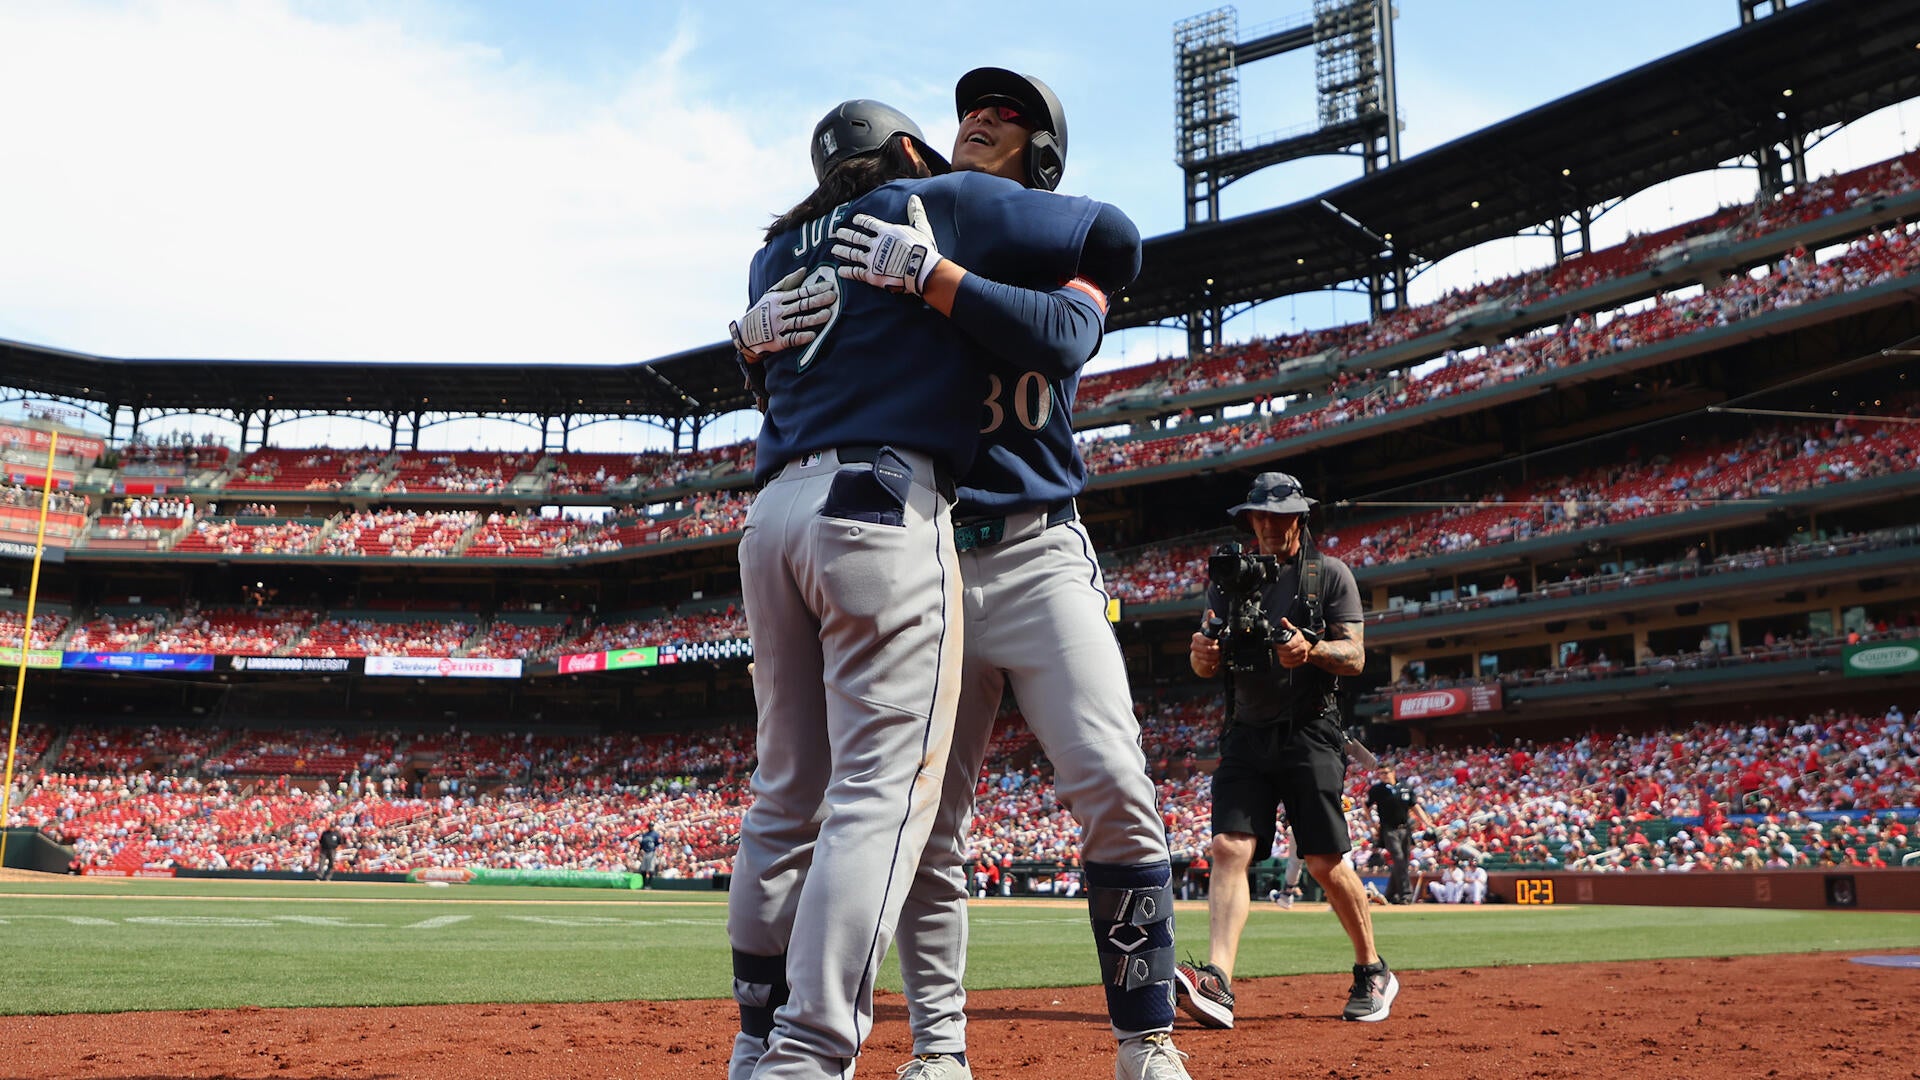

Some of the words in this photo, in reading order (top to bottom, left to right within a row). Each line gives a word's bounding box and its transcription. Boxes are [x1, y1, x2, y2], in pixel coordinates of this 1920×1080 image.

[979, 370, 1053, 434] 30
[303, 658, 350, 670] UNIVERSITY
[1400, 695, 1446, 712] HOFFMANN
[1516, 879, 1554, 904] 023
